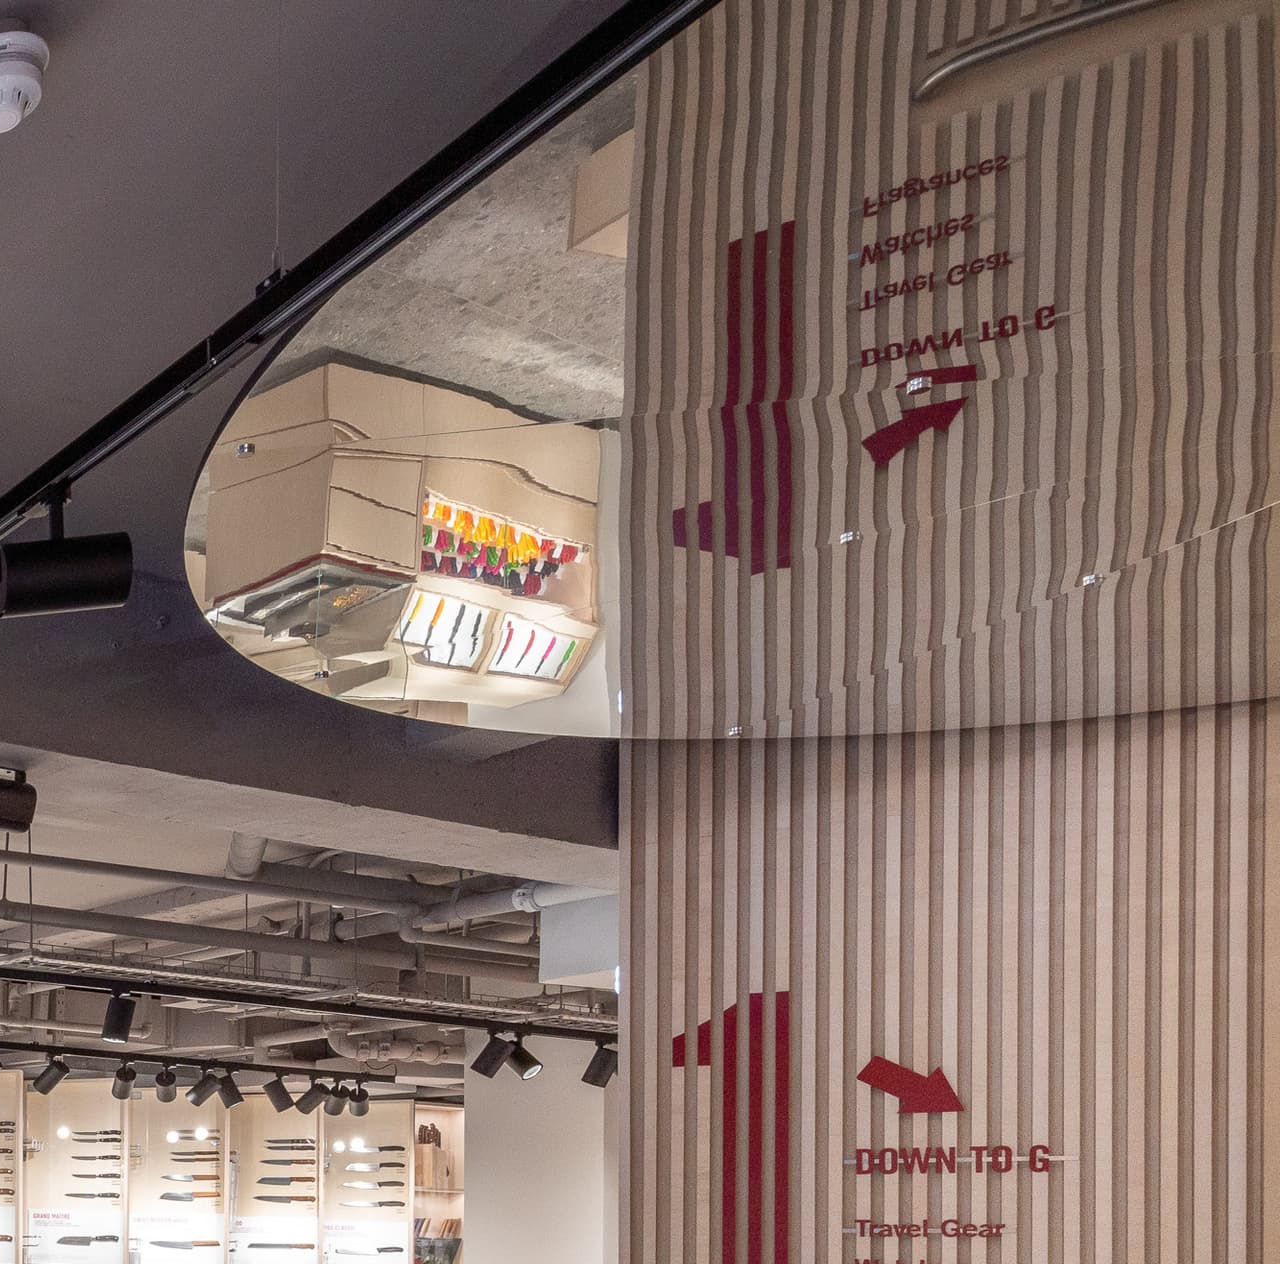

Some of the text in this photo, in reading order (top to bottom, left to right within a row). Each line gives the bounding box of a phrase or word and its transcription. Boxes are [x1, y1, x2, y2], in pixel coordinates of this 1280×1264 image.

[855, 1144, 1051, 1175] DOWN TO G
[855, 1219, 1006, 1239] Travel Gear
